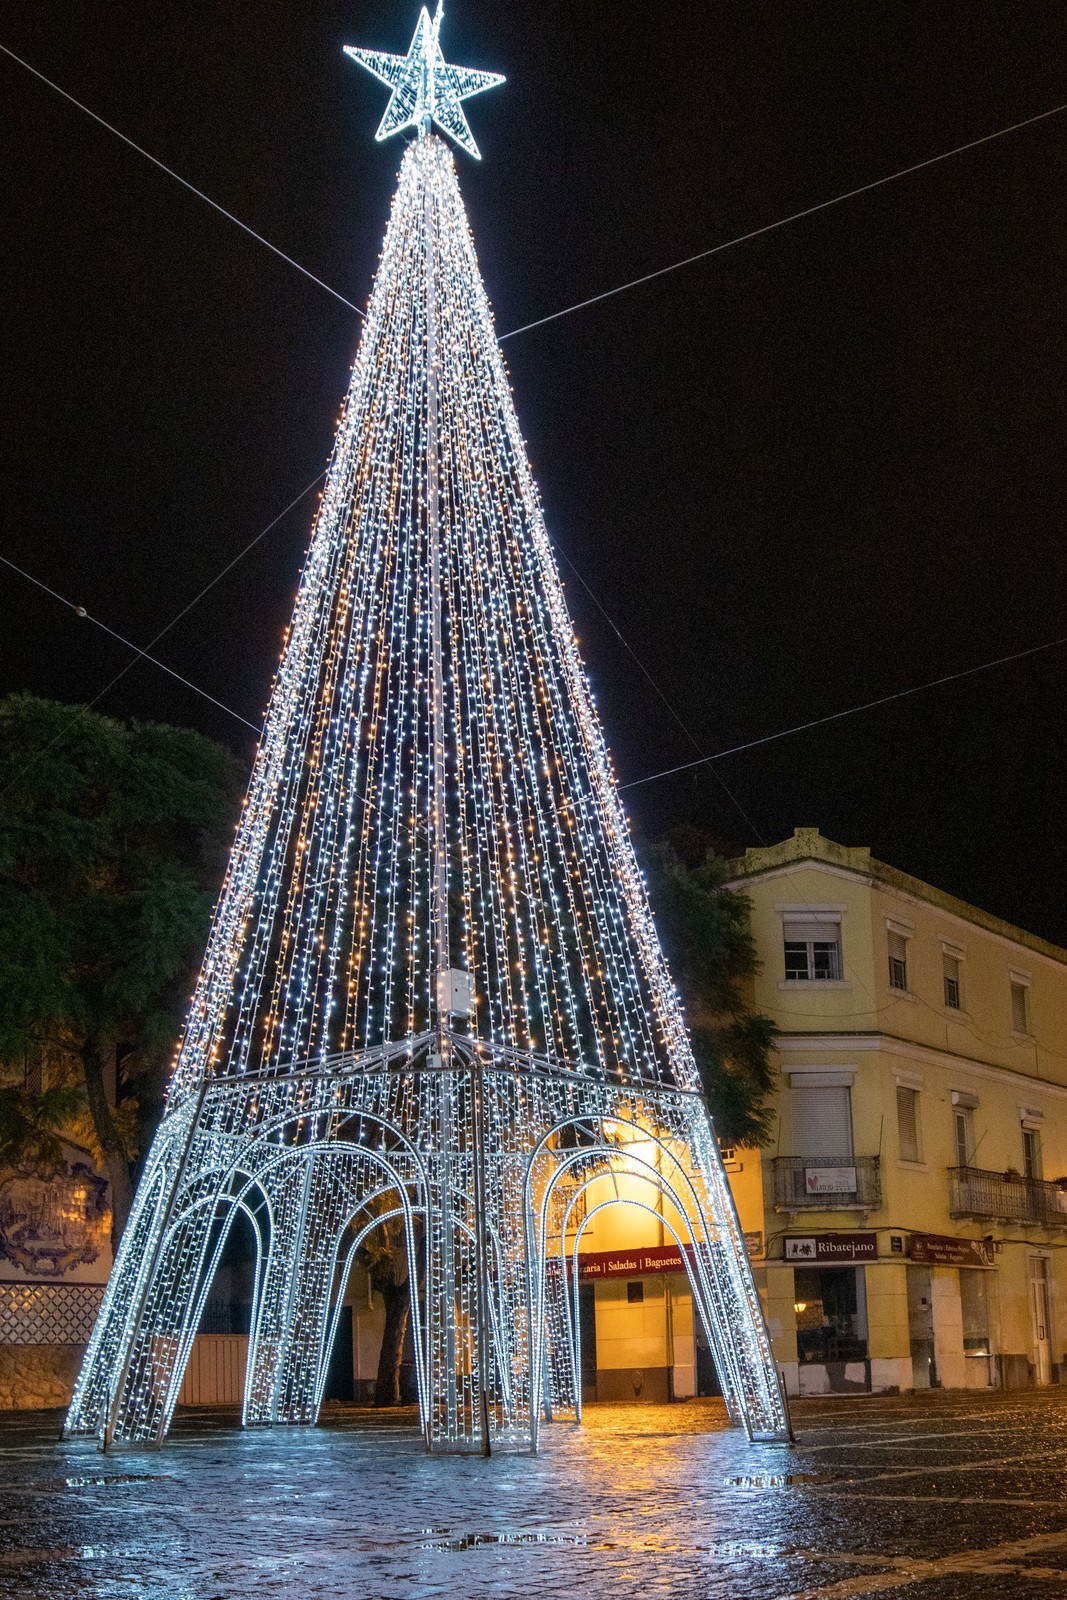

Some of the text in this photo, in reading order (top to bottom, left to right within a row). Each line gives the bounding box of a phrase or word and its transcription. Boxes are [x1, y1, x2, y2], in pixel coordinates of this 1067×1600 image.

[818, 1241, 874, 1258] Ribatejano
[608, 1259, 637, 1271] Saladas
[645, 1256, 682, 1269] Baguetes
